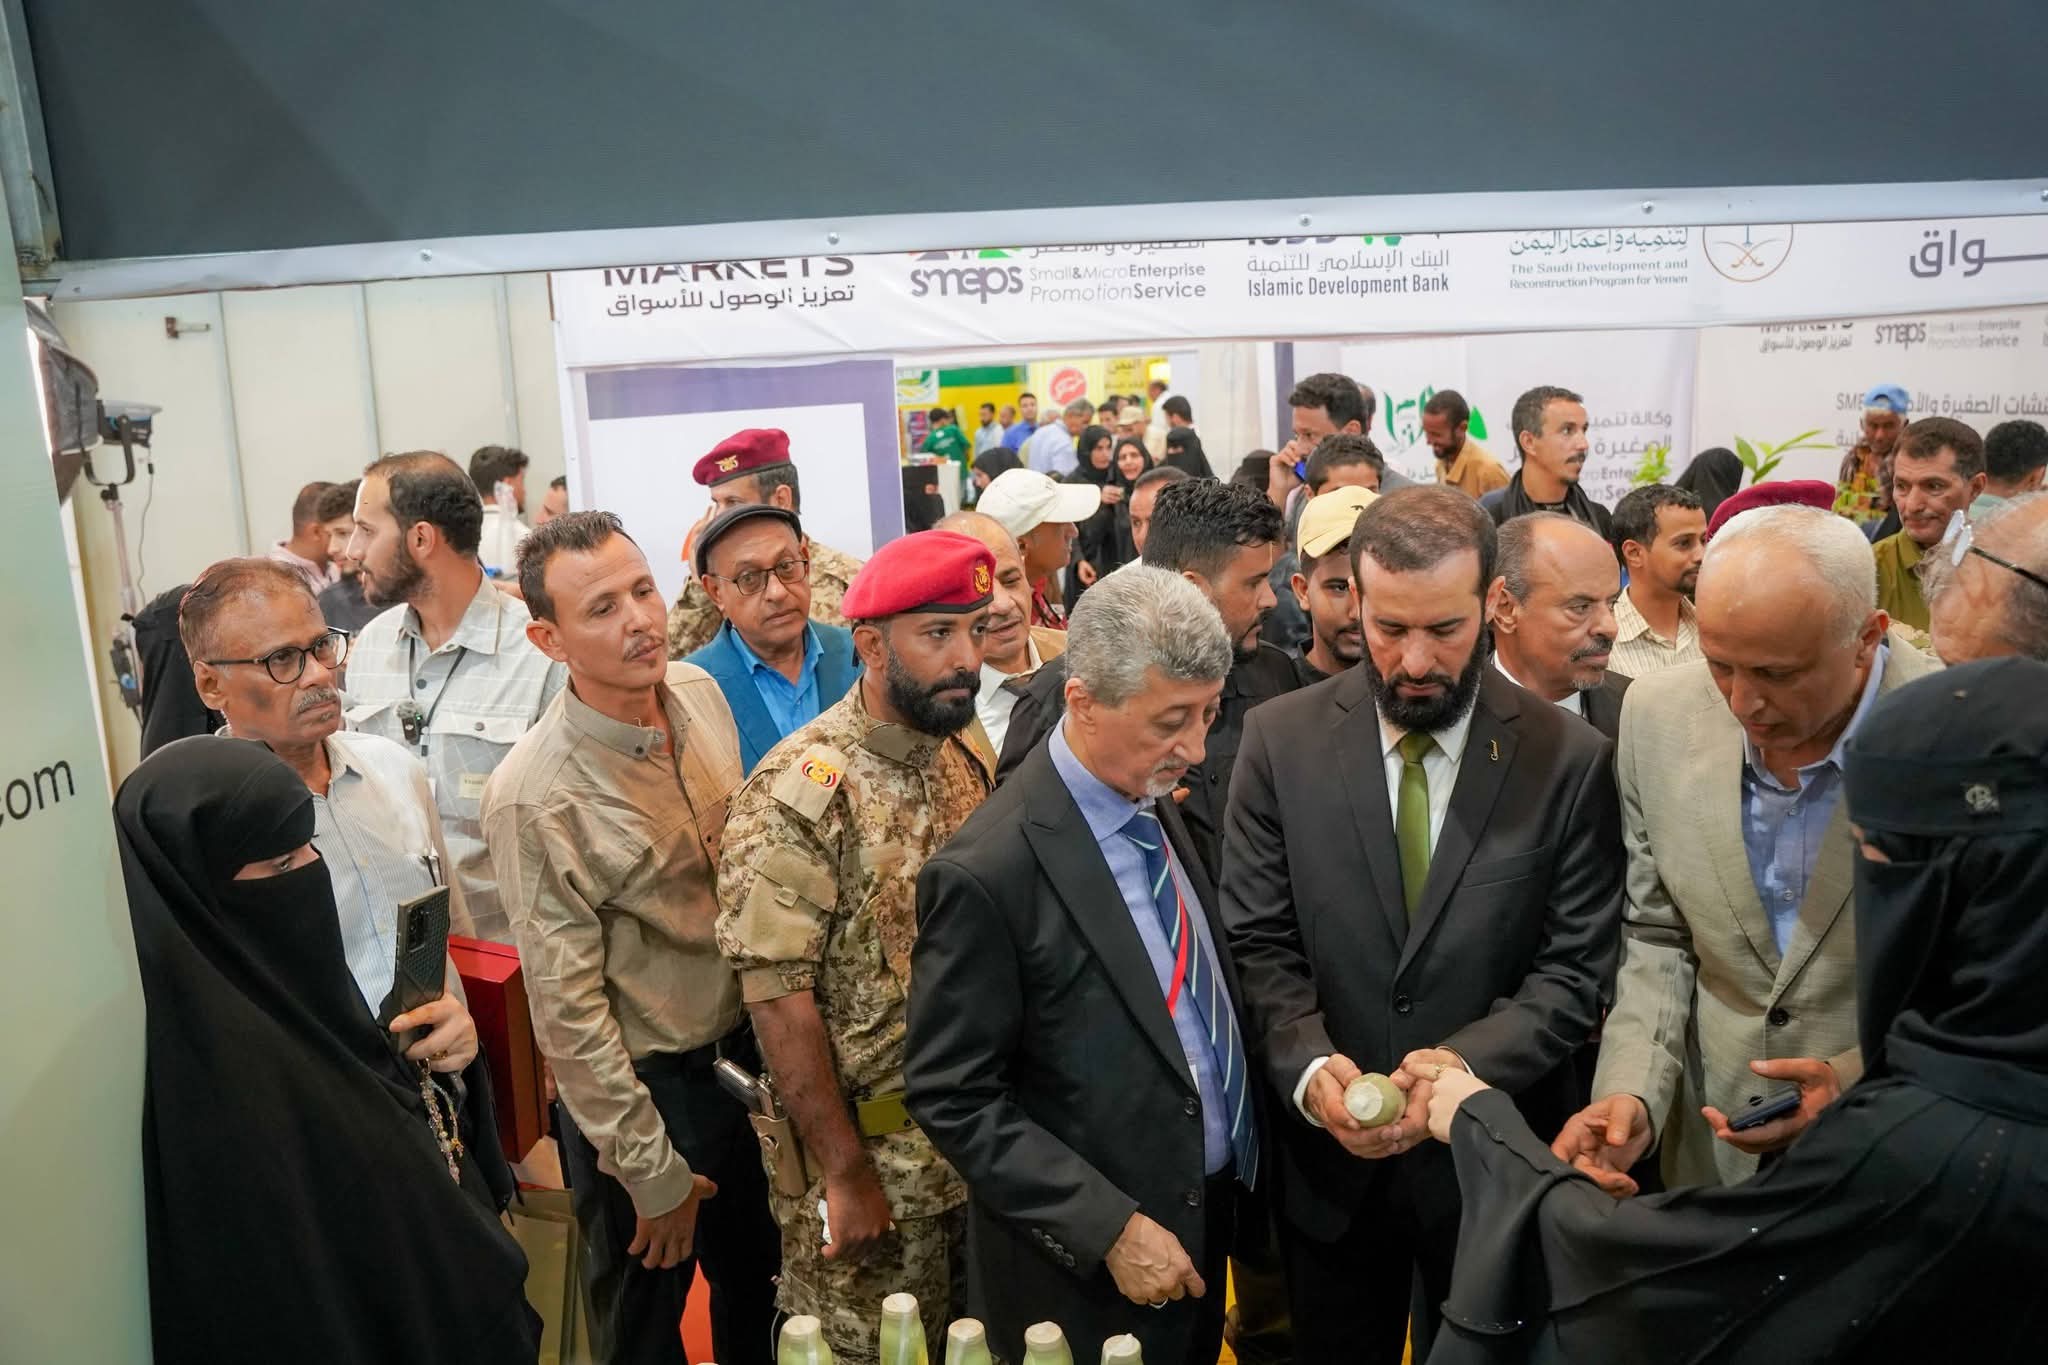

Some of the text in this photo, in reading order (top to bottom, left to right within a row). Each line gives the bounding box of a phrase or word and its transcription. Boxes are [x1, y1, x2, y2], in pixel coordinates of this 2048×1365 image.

[1247, 253, 1310, 277] للتنمية
[1410, 249, 1449, 272] البنك
[1511, 258, 1688, 275] The Saudi Development and
[910, 266, 1024, 304] smeps
[1248, 273, 1449, 298] Islamic Development Bank
[1509, 275, 1588, 289] Reconstruction
[1589, 274, 1635, 288] Program
[1653, 273, 1688, 285] Yemen
[607, 284, 856, 317] تعزيز الوصول للأسواق
[1590, 410, 1628, 430] تنمي
[0, 760, 75, 828] om
